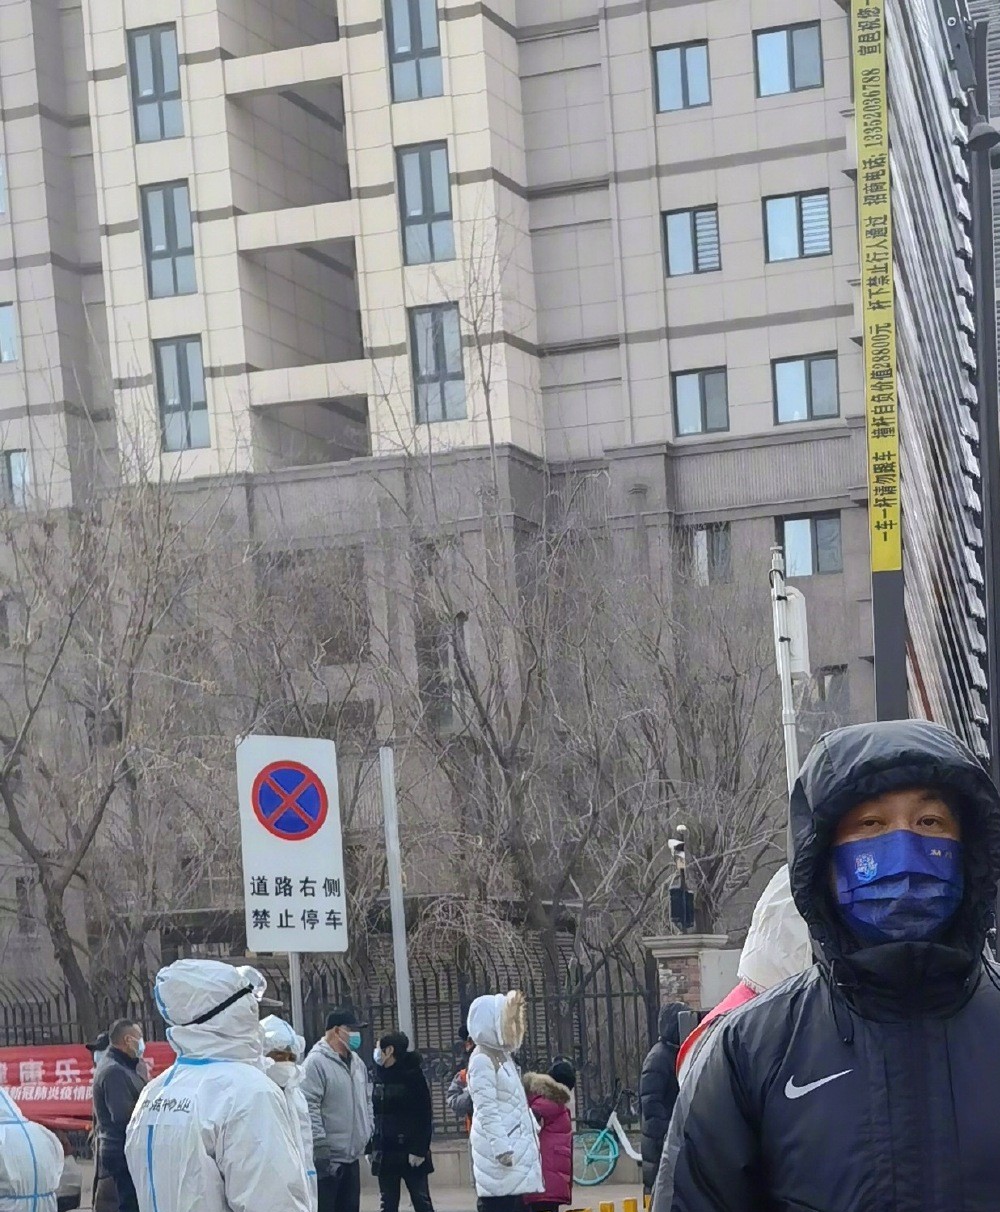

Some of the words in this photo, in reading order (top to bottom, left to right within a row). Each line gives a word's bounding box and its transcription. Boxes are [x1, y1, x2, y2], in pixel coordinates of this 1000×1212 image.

[864, 213, 892, 311] 杆下禁止行人通过
[869, 322, 896, 439] 撞杆自负价值28800元
[873, 450, 897, 542] 一车一杆请勿跟车
[250, 875, 341, 898] 道路右侧
[252, 908, 343, 931] 禁止停车
[4, 1085, 94, 1101] 新冠肺炎疫情防
